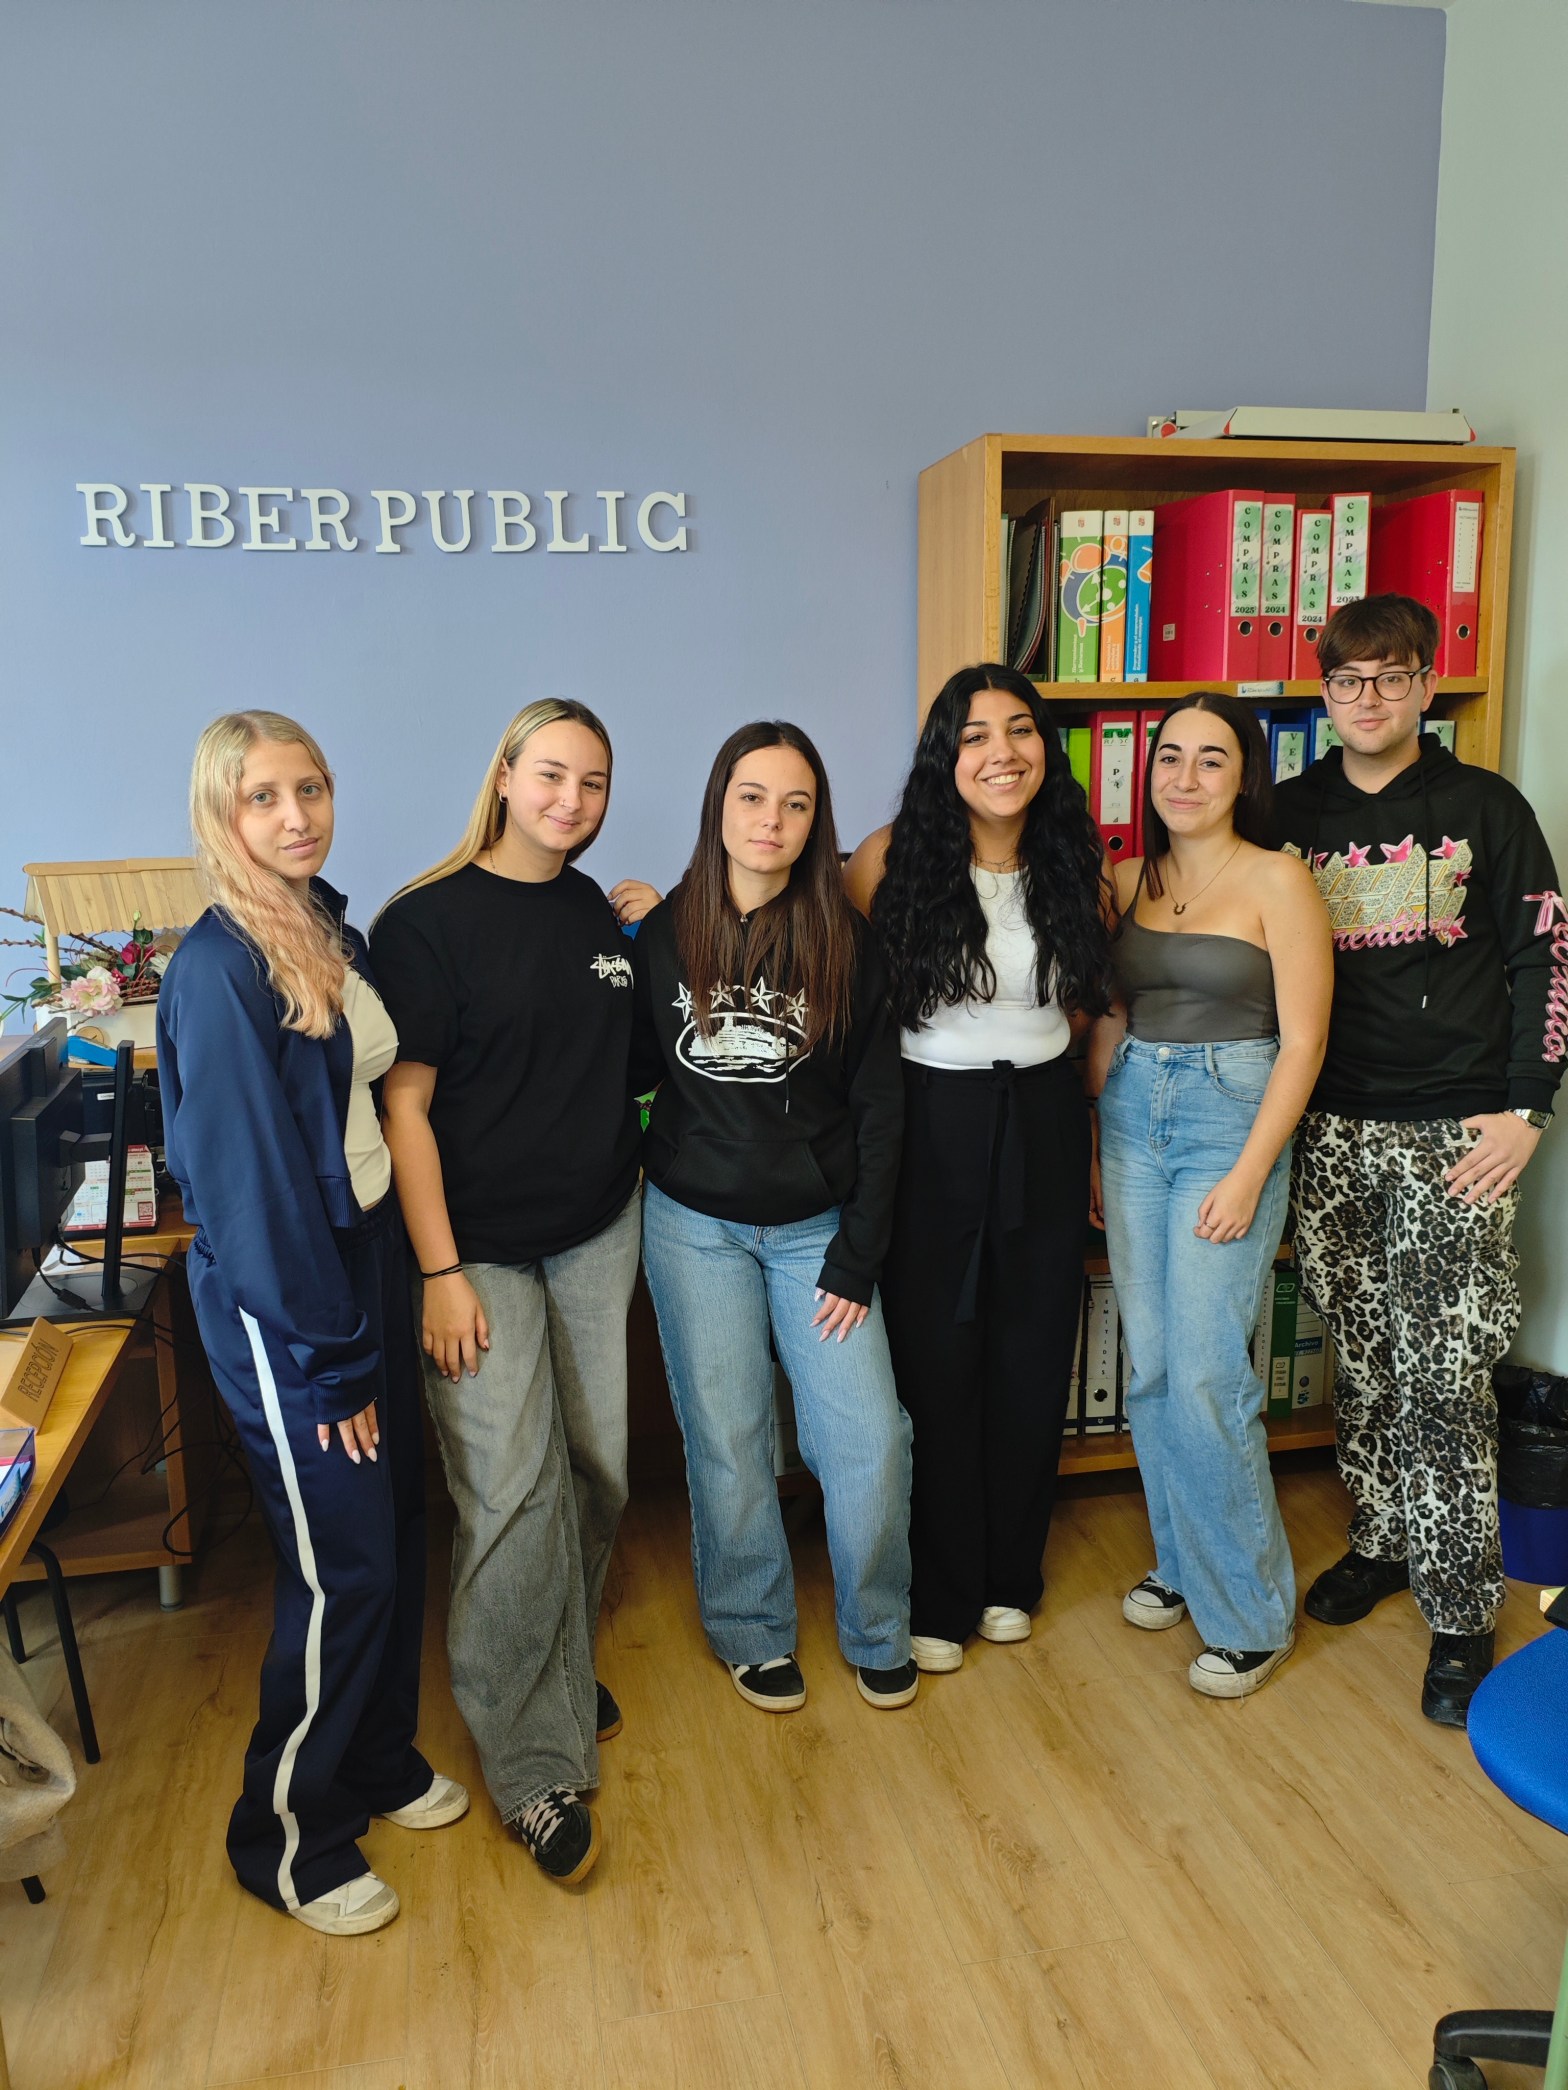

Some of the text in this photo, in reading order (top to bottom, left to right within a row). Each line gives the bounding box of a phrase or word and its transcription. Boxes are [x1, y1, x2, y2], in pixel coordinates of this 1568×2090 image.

[1241, 507, 1251, 598] COMPRAS
[1271, 510, 1281, 600] COMPRAS
[1308, 519, 1321, 609] COMPRAS
[1344, 502, 1355, 590] COMPRAS
[1234, 606, 1255, 614] 2025
[1264, 606, 1286, 614] 2024
[1301, 615, 1322, 623] 2024
